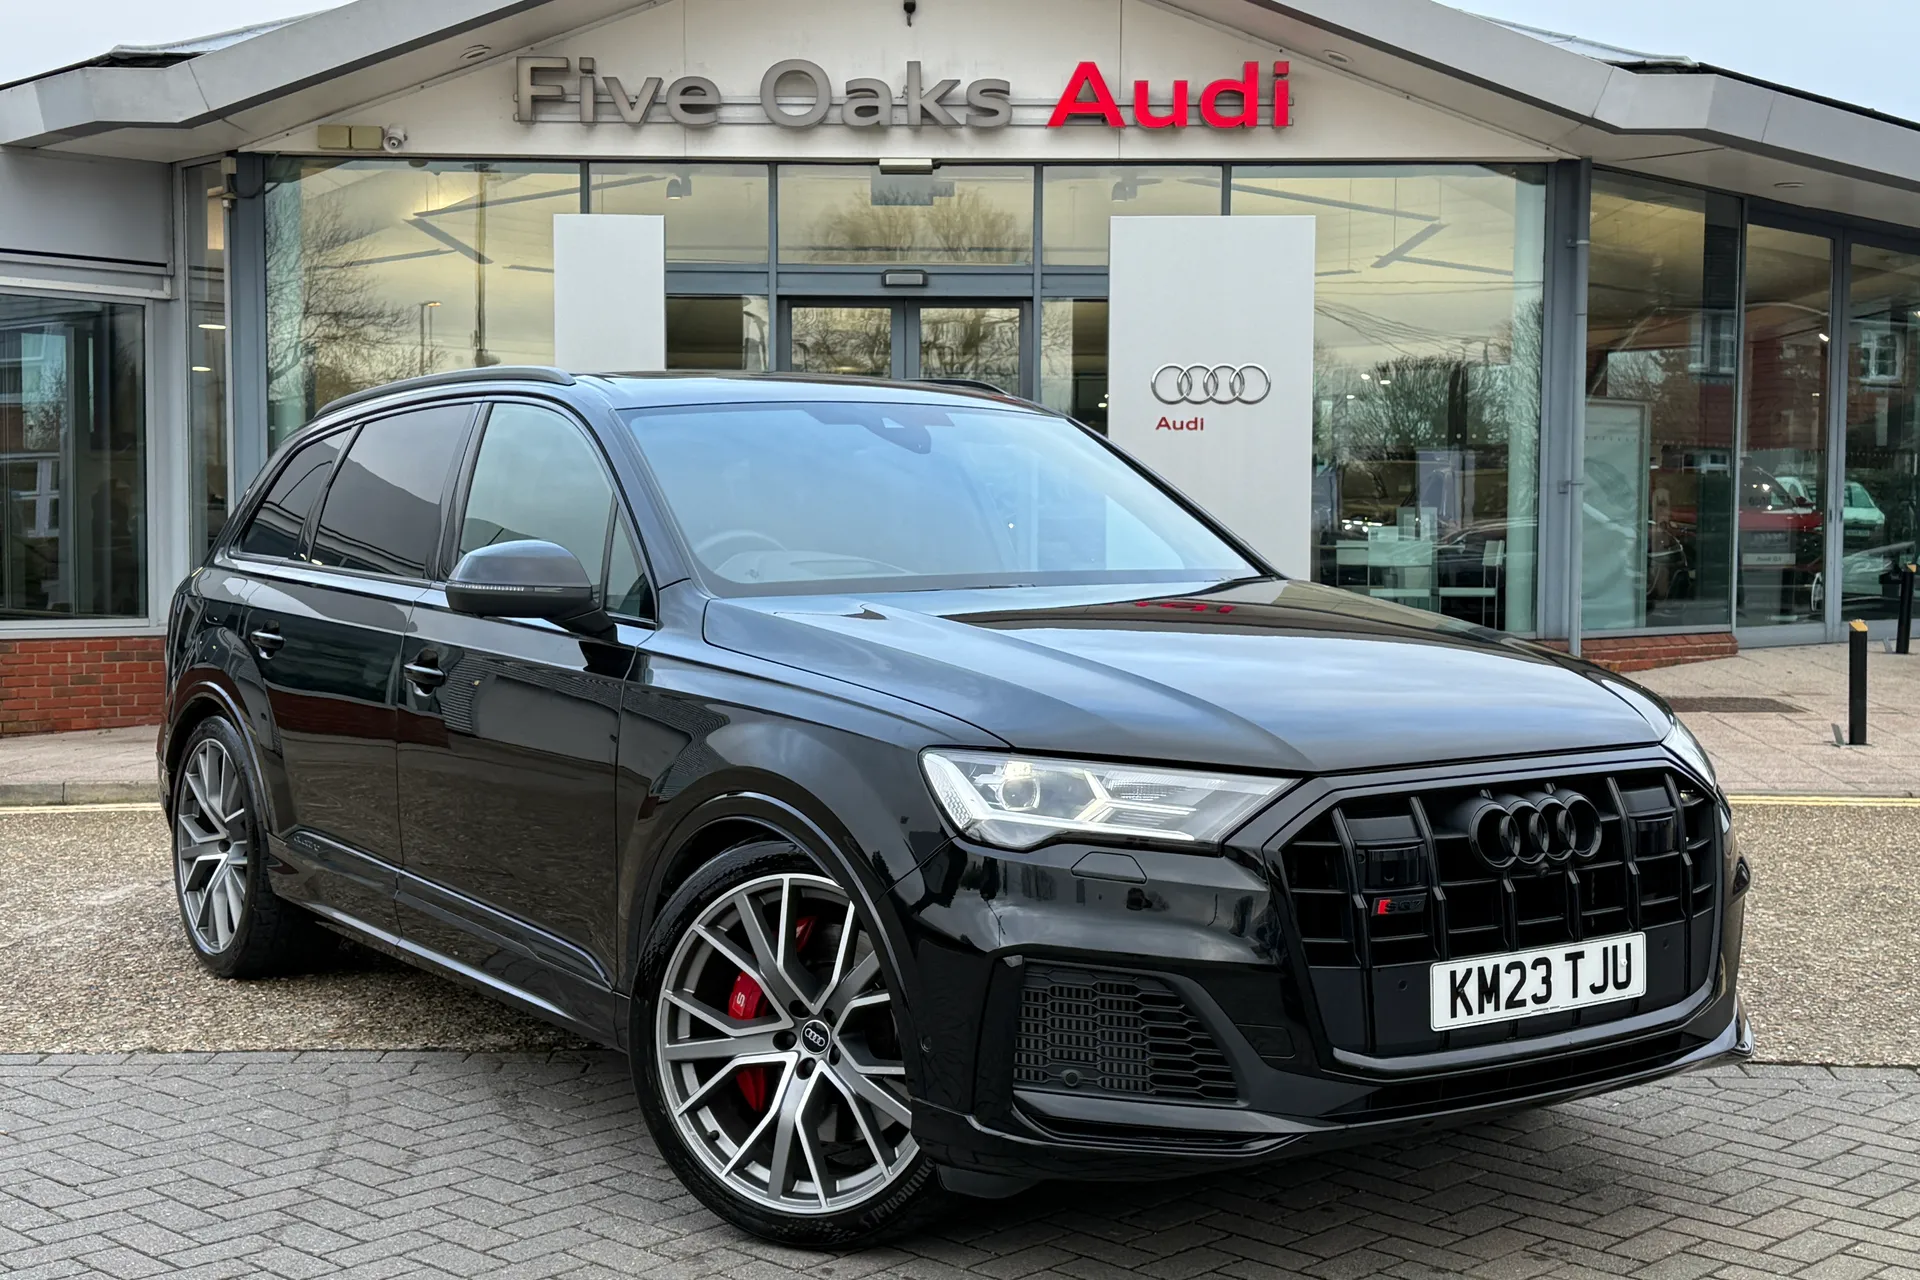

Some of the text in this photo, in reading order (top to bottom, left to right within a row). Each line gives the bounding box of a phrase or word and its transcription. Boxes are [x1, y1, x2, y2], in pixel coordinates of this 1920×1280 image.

[516, 56, 1290, 129] Five Oaks Audi
[1155, 416, 1205, 431] Audi
[1385, 898, 1423, 914] SQ7
[1449, 942, 1633, 1020] KM23 TJU
[870, 1155, 936, 1223] ontinental
